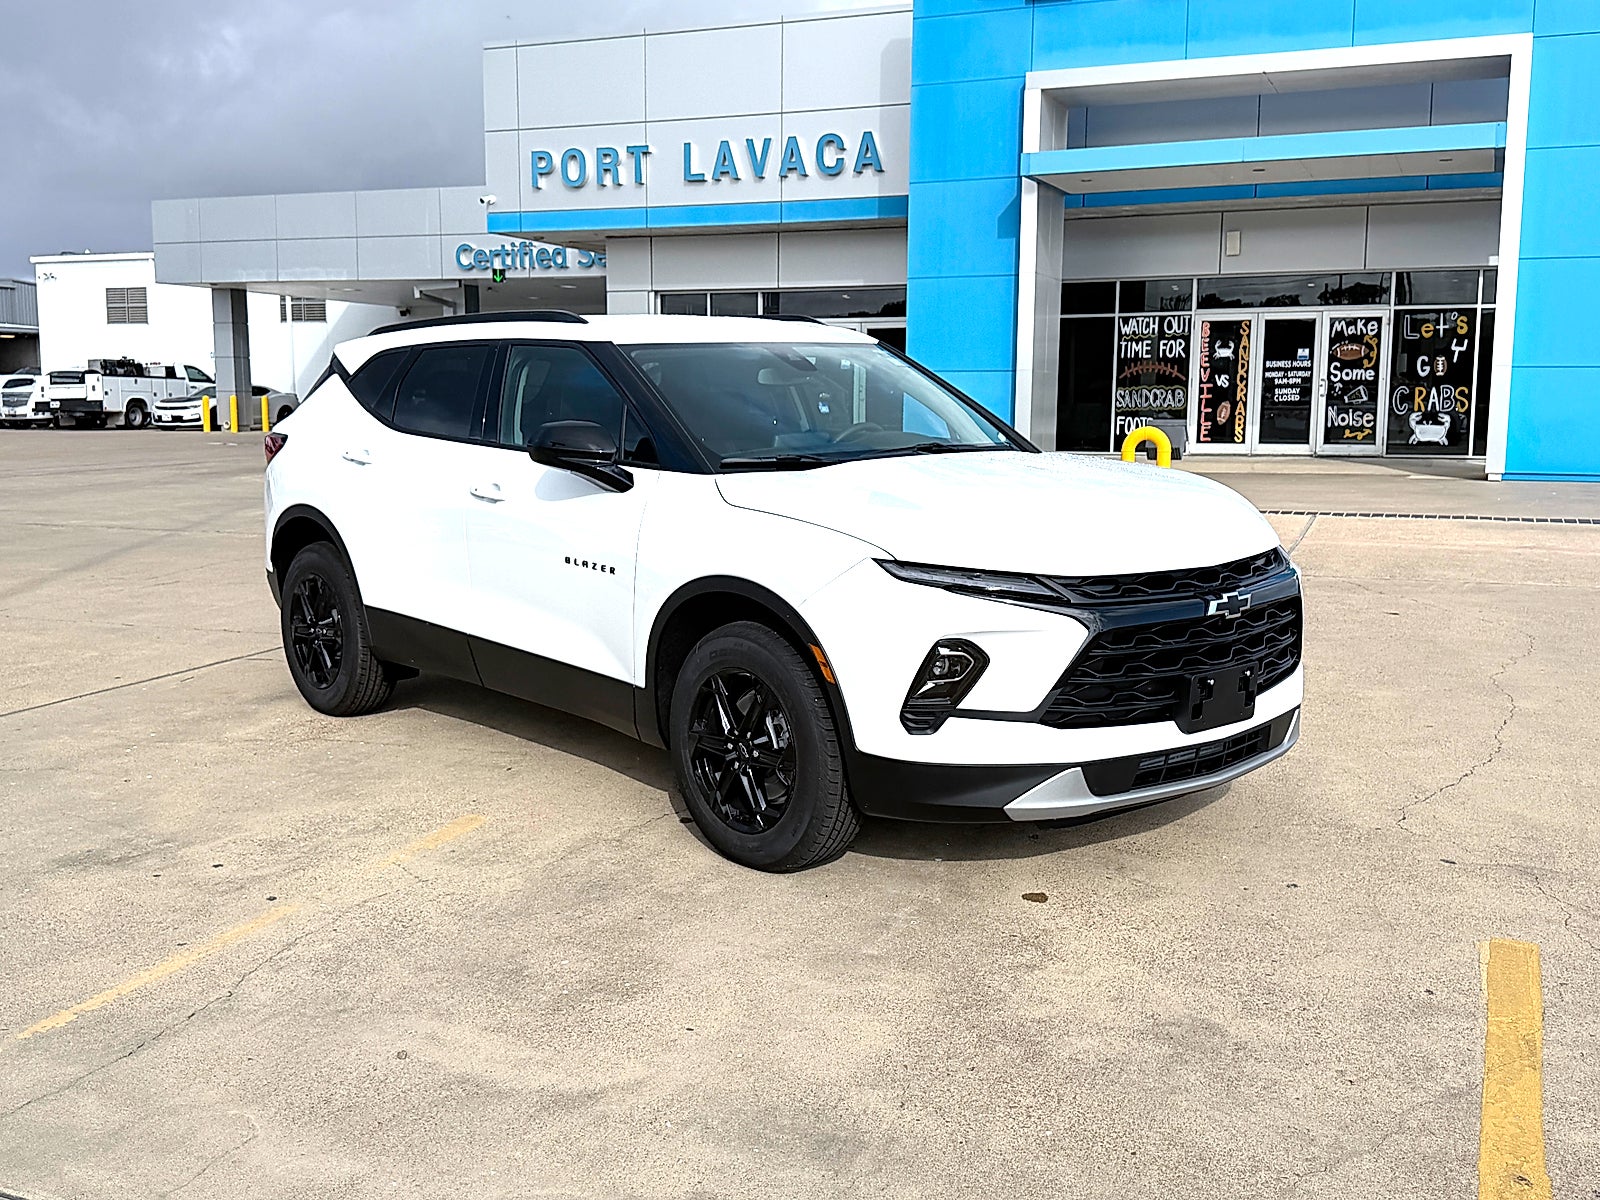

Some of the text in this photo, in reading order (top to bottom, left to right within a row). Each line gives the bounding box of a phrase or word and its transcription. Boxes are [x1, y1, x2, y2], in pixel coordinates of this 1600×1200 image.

[531, 131, 883, 189] PORT LAVACA
[456, 242, 569, 271] Certified
[1119, 315, 1191, 335] WATCH OUT
[1120, 339, 1186, 359] TIME FOR
[1265, 360, 1311, 368] BUSINESS HOURS
[1287, 370, 1311, 378] SATURDAY
[1330, 362, 1375, 382] Some
[1200, 321, 1213, 442] BEEVILLE
[1215, 373, 1230, 388] VS
[1234, 320, 1250, 443] SANDCRABS
[1115, 388, 1186, 408] SANDCRAB
[1274, 387, 1300, 395] SUNDAY
[1274, 394, 1300, 402] CLOSED
[1392, 385, 1469, 415] CRABS
[1116, 416, 1154, 436] FOOT
[564, 556, 616, 575] BLAZER
